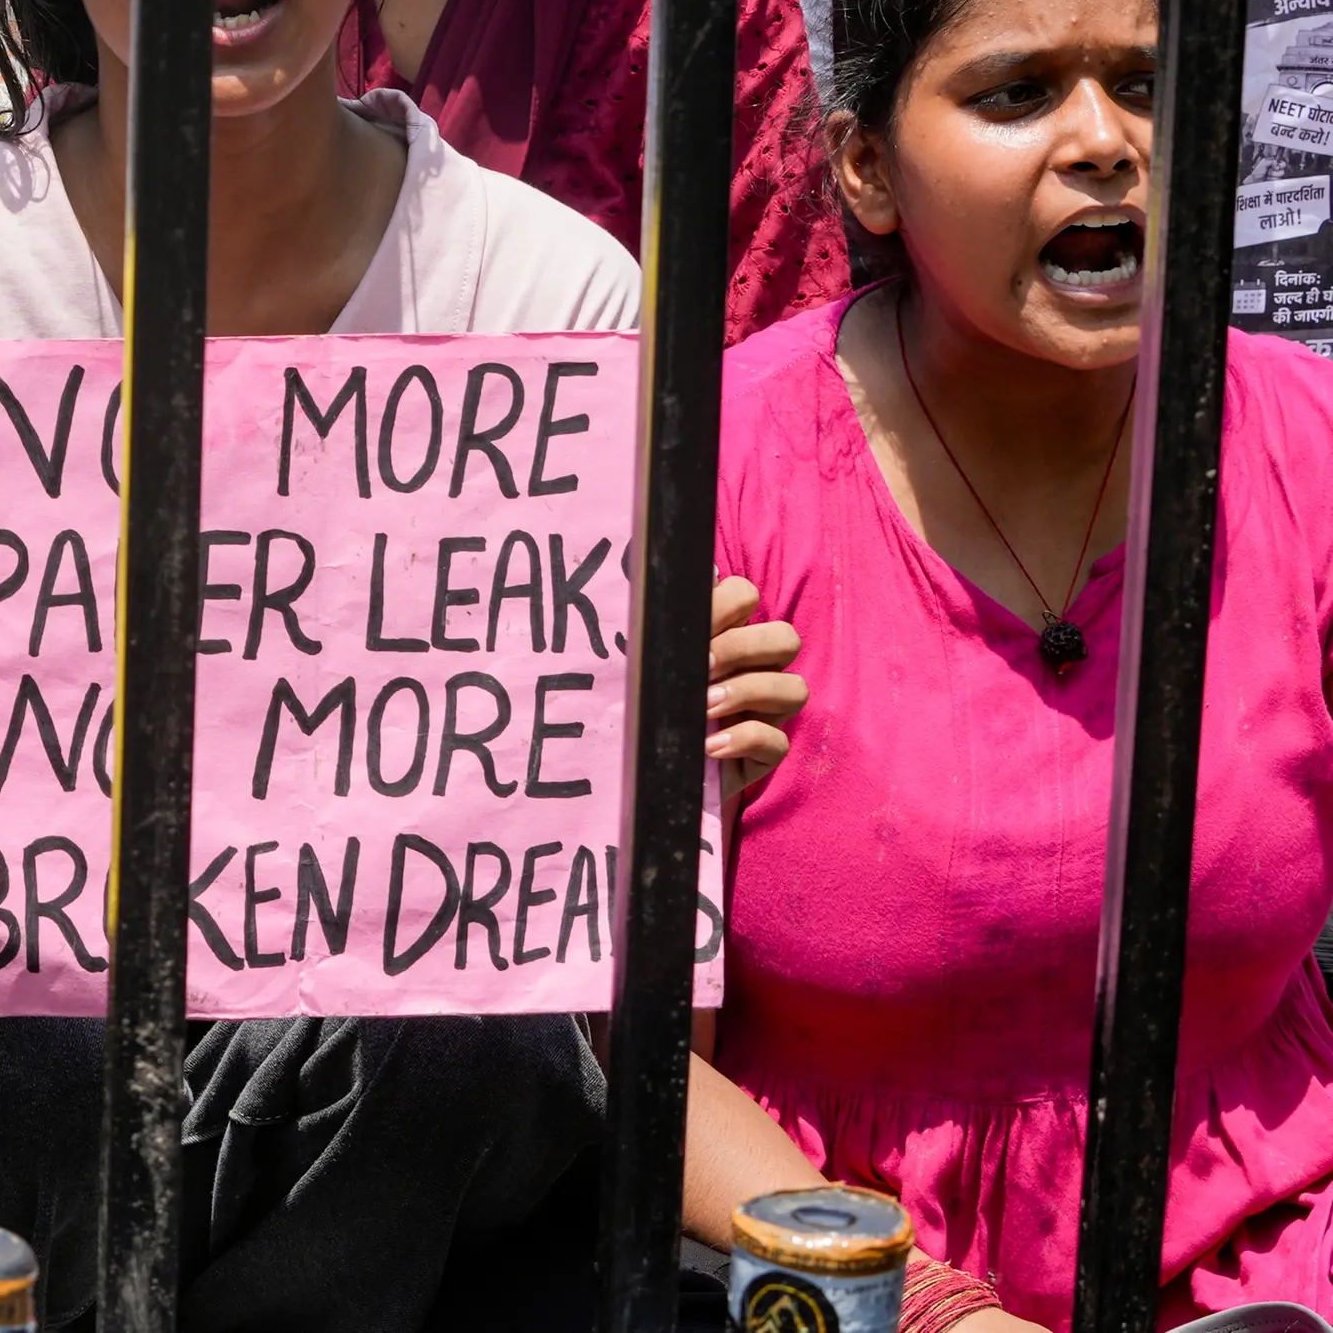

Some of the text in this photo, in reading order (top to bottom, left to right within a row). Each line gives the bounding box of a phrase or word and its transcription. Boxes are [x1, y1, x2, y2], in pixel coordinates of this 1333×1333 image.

[1268, 98, 1306, 119] NEET
[1270, 122, 1297, 139] बन्द
[1264, 190, 1274, 207] में
[1273, 290, 1303, 305] जल्द
[1305, 286, 1319, 304] ही
[1272, 307, 1291, 325] की
[276, 361, 599, 500] MORE
[365, 529, 632, 660] LEAK
[251, 671, 595, 801] MORE
[382, 833, 724, 978] DREAS
